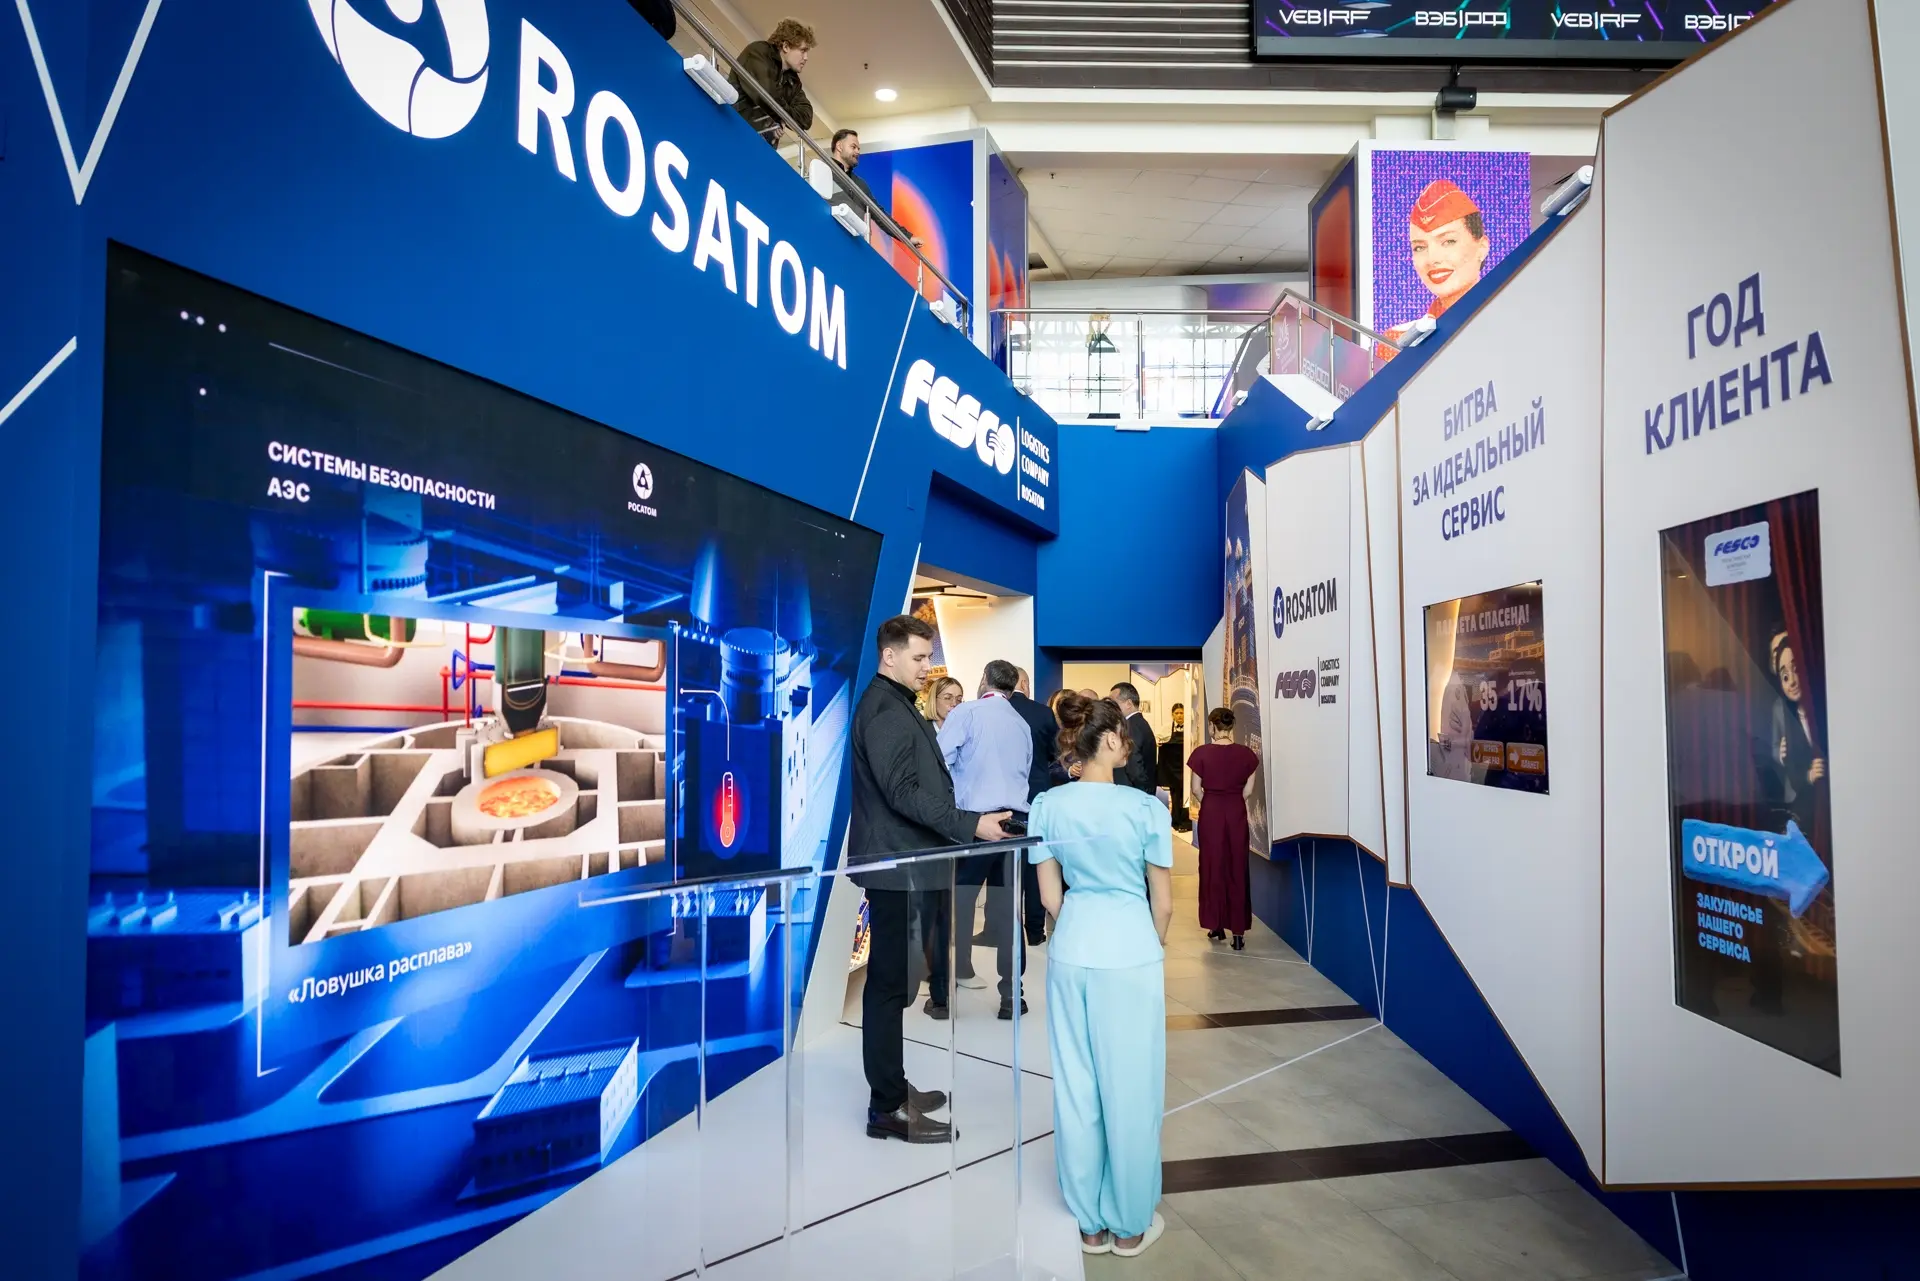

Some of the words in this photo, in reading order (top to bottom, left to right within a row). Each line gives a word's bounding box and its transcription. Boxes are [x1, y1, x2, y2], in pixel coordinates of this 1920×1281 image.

[517, 17, 848, 371] ROSATOM
[1687, 272, 1766, 360] ГОД
[1645, 330, 1834, 455] КЛИЕНТА
[900, 359, 1016, 475] FESCO
[1444, 380, 1498, 441] БИТВА
[1021, 427, 1050, 464] LOGISTICS
[1412, 471, 1430, 506] ЗА
[1433, 395, 1545, 498] ИДЕАЛЬНЫЙ
[267, 440, 367, 481] СИСТЕМЫ
[369, 465, 496, 510] БЕЗОПАСНОСТИ
[1021, 454, 1050, 487] COMPANY
[267, 477, 311, 503] АЭС
[1021, 484, 1045, 511] ROSATOM
[627, 501, 658, 517] РОСАТОМ
[1442, 485, 1506, 541] СЕРВИС
[1713, 534, 1760, 556] FESCO
[1286, 577, 1338, 625] ROSATOM
[1479, 603, 1530, 631] СПАСЕНА!
[1320, 658, 1340, 671] LOGISTICS
[1320, 674, 1340, 687] COMPANY
[1275, 669, 1317, 699] FESCO
[1480, 680, 1498, 711] 35
[1507, 678, 1542, 712] 17%
[1692, 835, 1779, 879] ОТКРОЙ
[1696, 892, 1764, 925] ЗАКУЛИСЬЕ
[1697, 912, 1744, 940] НАШЕГО
[1698, 932, 1752, 963] СЕРВИСА
[287, 963, 385, 1004] «Ловушка
[388, 941, 473, 982] расплава»
